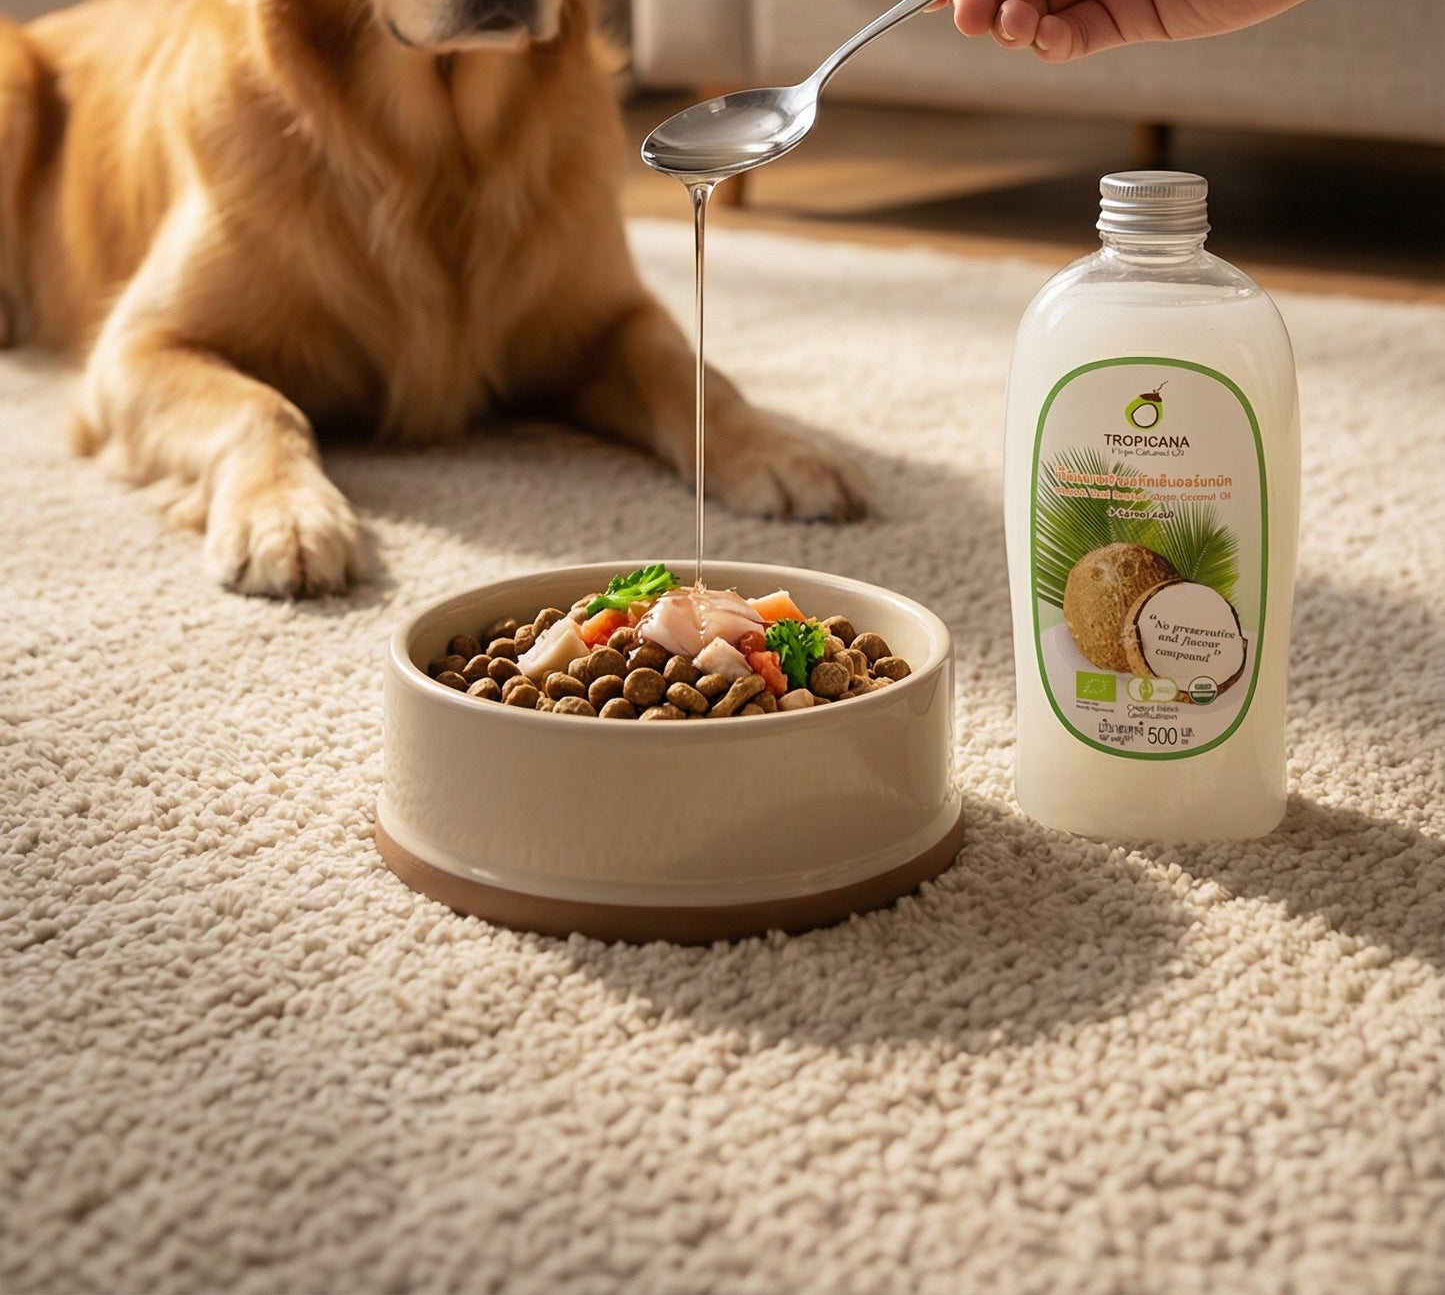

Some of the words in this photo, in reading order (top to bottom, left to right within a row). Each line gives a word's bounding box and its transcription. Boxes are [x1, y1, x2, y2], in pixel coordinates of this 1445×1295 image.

[1103, 433, 1190, 448] TROPICANA
[1157, 633, 1180, 643] and
[1147, 727, 1178, 745] 500
